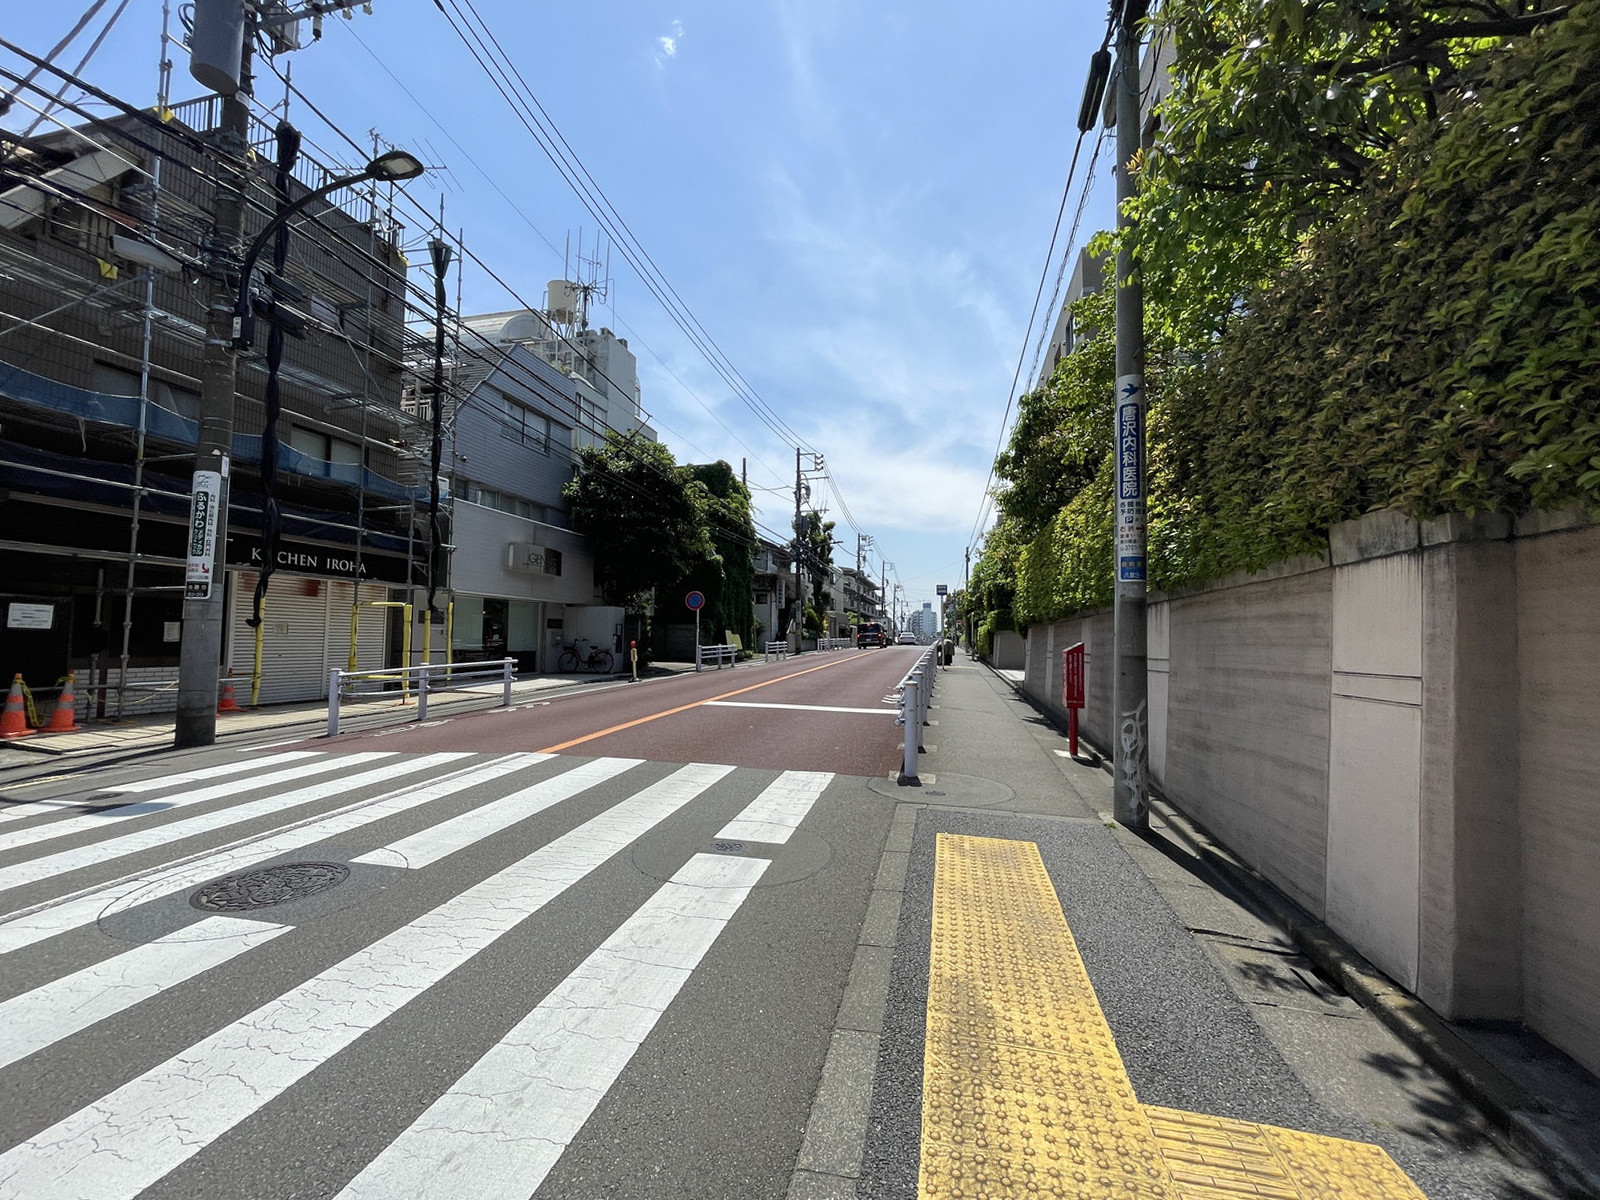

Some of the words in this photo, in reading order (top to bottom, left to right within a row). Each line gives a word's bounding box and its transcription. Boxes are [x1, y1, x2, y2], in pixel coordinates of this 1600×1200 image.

[1122, 406, 1138, 497] 唐沢内科医院
[195, 492, 207, 528] ふるかわ
[251, 547, 318, 567] KCHEN
[326, 558, 367, 573] IROHA
